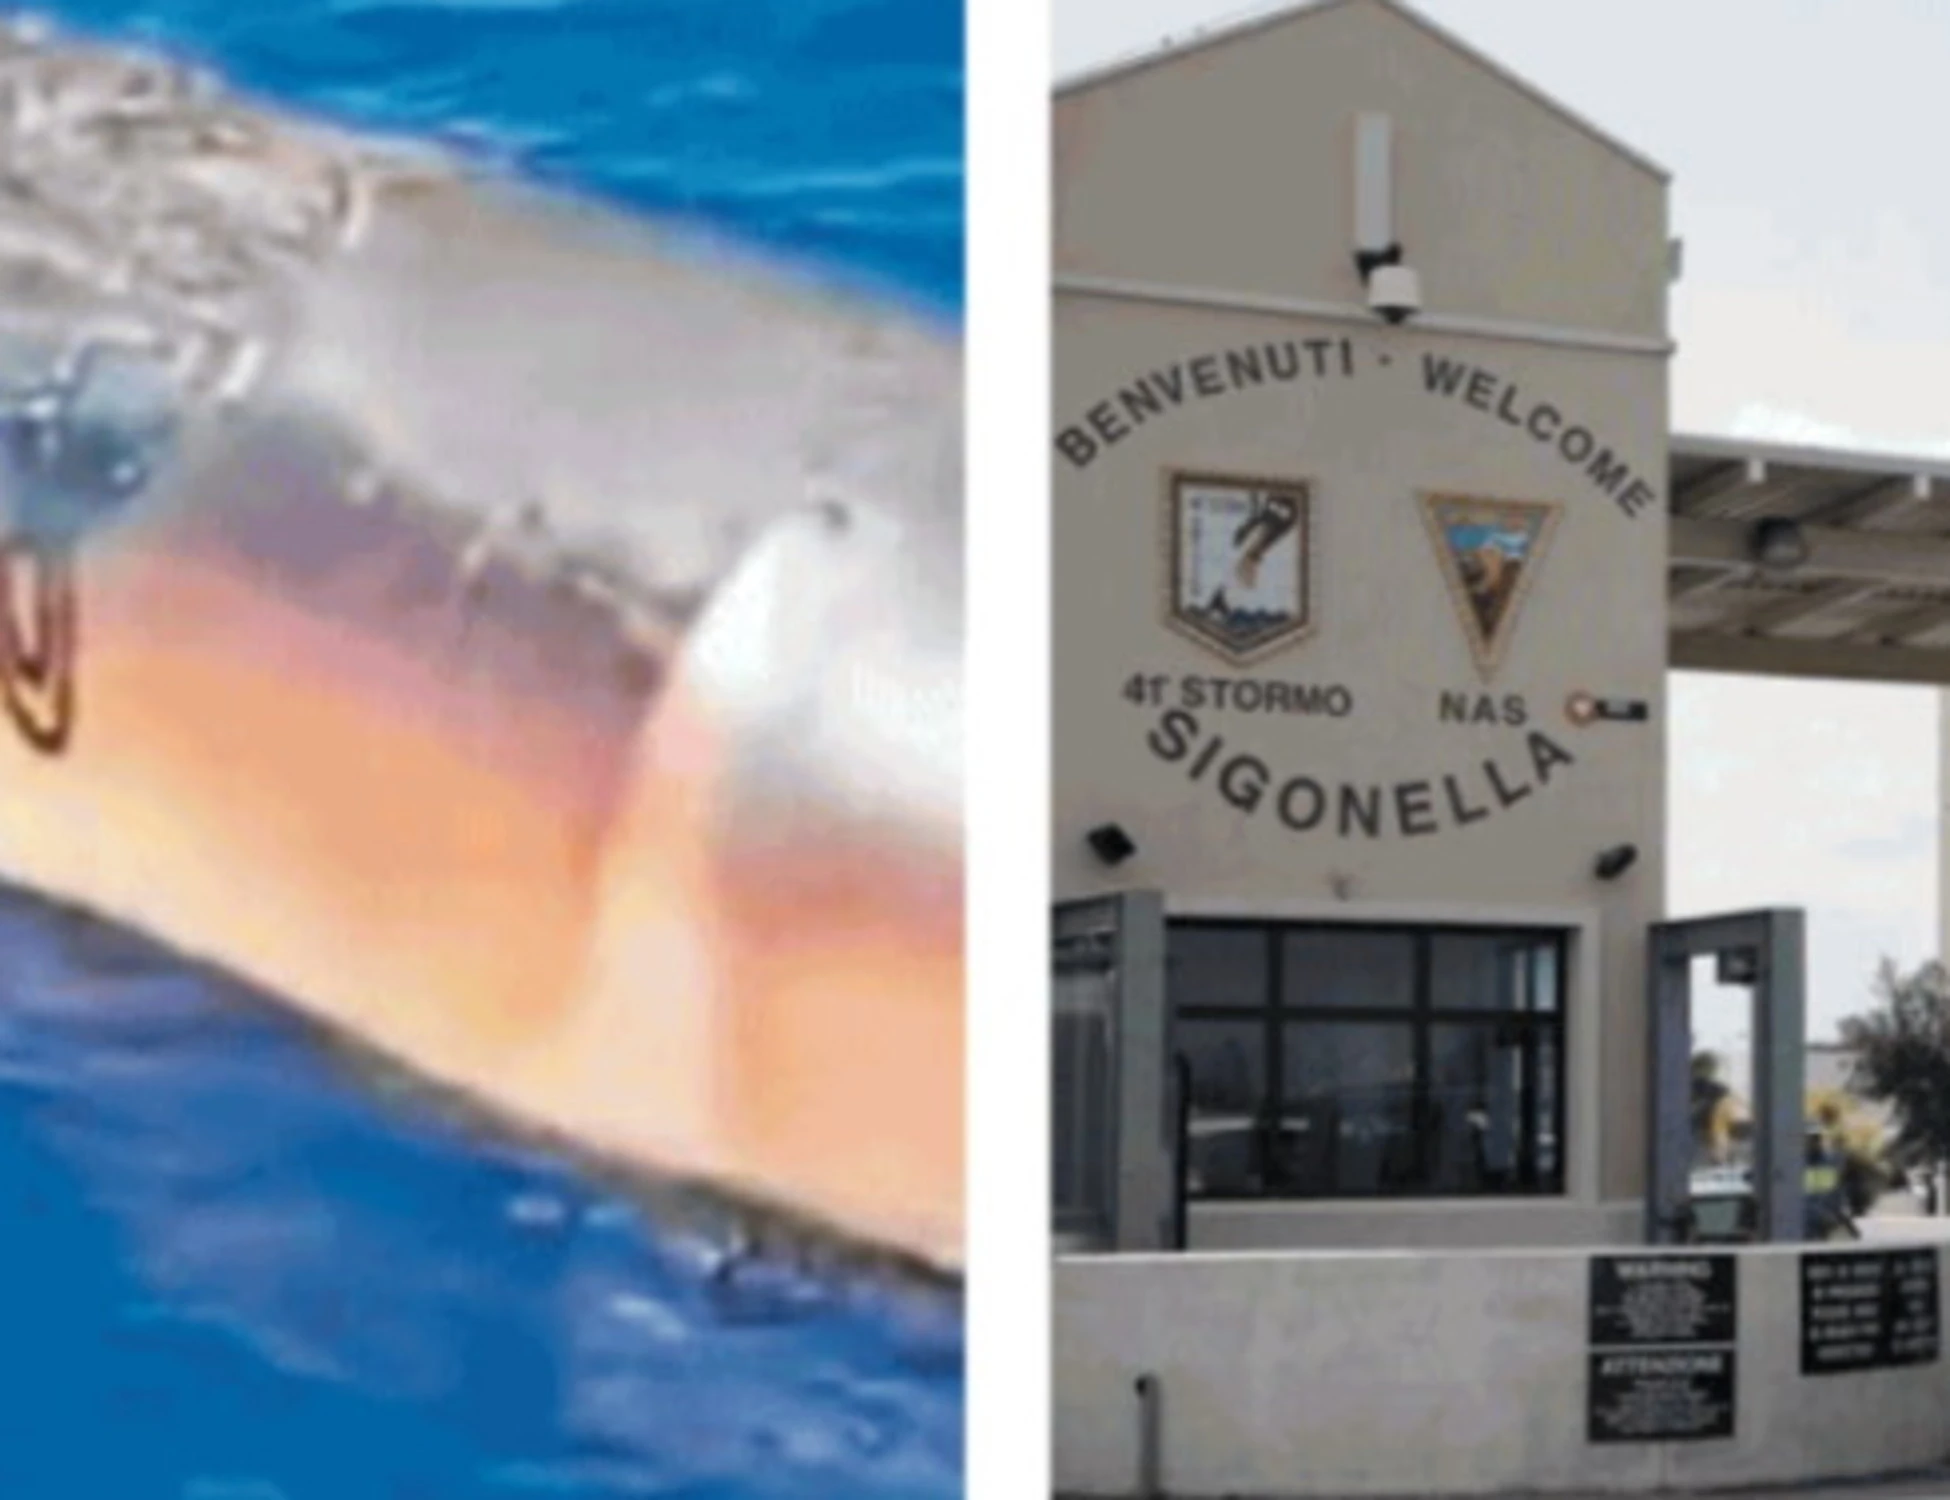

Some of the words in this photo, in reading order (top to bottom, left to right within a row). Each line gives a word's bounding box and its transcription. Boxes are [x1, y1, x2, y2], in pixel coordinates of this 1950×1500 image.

[1054, 337, 1354, 469] BENVENUTI
[1421, 353, 1655, 520] WELCOME
[1180, 675, 1353, 718] STORMO
[1438, 690, 1527, 726] NAS
[1146, 708, 1574, 838] SIGONELLA
